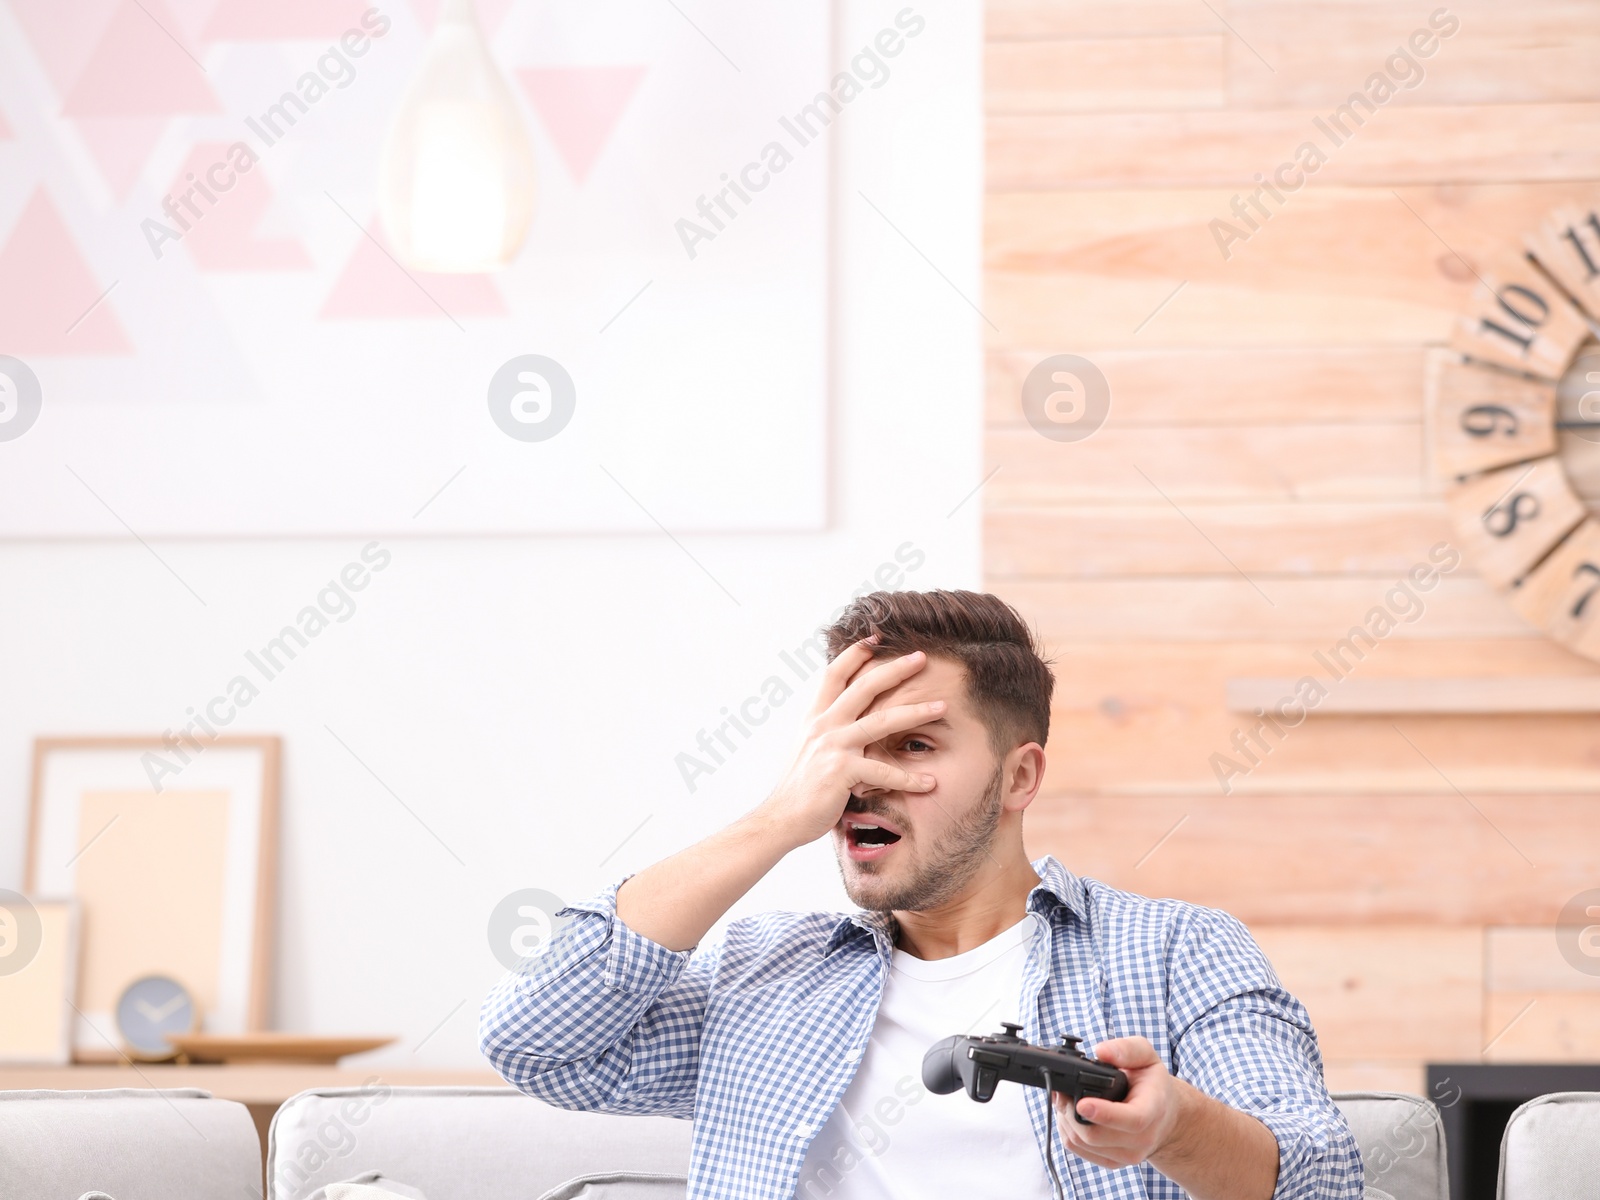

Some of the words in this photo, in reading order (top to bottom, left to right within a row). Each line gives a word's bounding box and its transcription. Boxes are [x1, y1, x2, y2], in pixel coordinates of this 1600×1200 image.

[1479, 284, 1550, 357] 10
[1460, 404, 1518, 439] 9
[1483, 492, 1540, 538] 8
